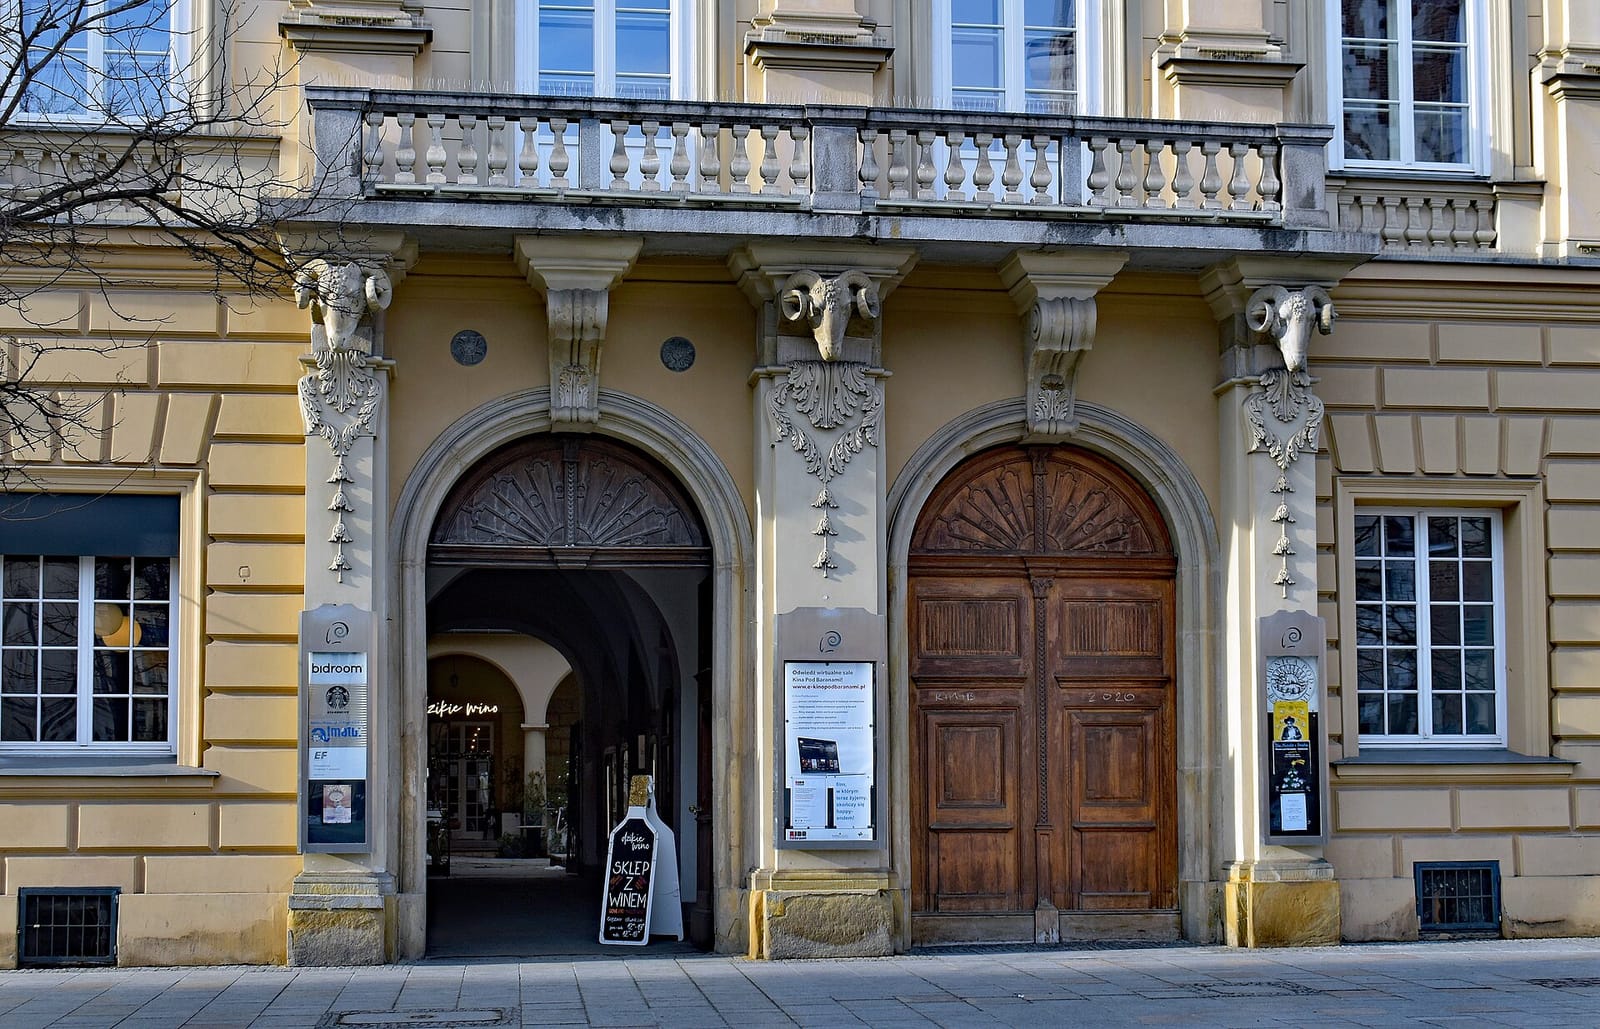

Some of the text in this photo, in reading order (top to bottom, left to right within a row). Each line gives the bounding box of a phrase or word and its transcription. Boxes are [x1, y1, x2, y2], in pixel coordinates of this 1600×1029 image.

[312, 663, 362, 674] bidroom
[427, 700, 499, 718] zikie wino
[314, 751, 328, 760] EF
[632, 842, 650, 851] wino
[612, 860, 650, 876] SKLEP
[623, 876, 635, 891] Z
[608, 892, 647, 909] WINEM
